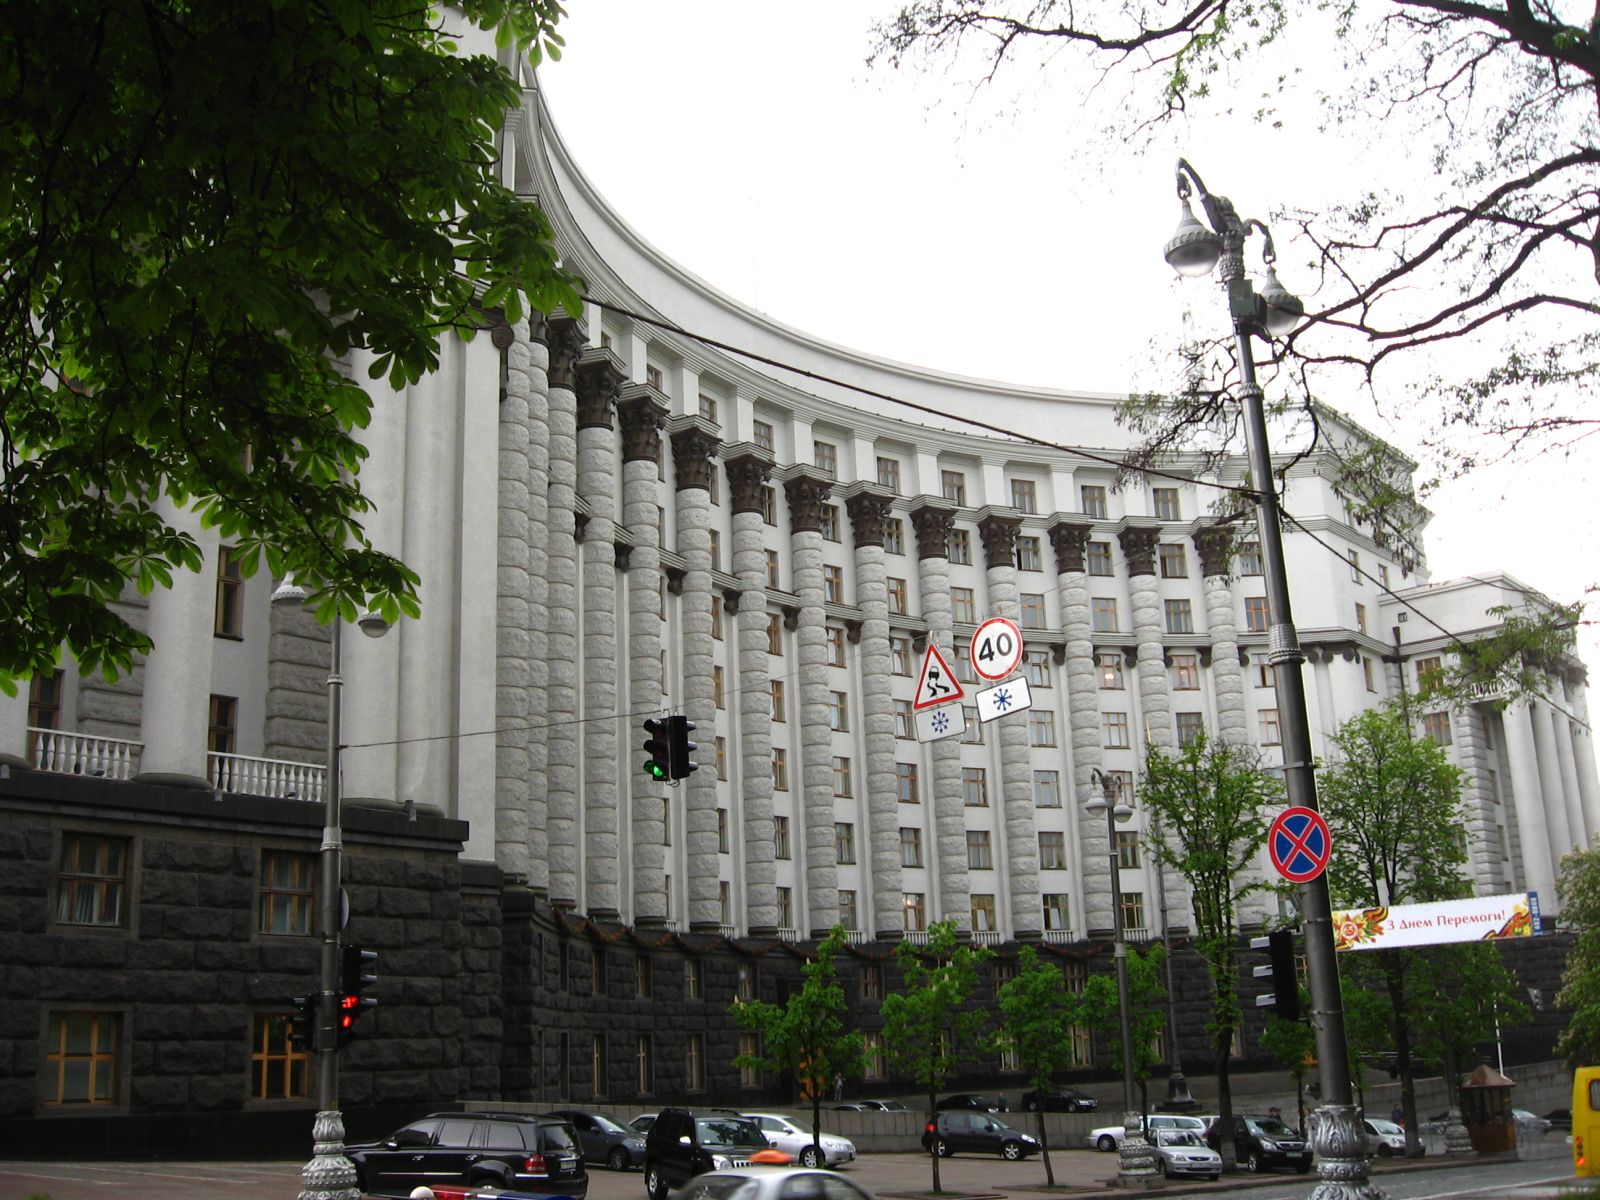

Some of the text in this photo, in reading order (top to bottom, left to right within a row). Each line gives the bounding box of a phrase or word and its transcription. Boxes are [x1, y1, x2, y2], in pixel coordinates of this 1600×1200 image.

[979, 632, 1012, 661] 40
[1399, 919, 1433, 930] Днем
[1437, 910, 1505, 928] Перемоги!
